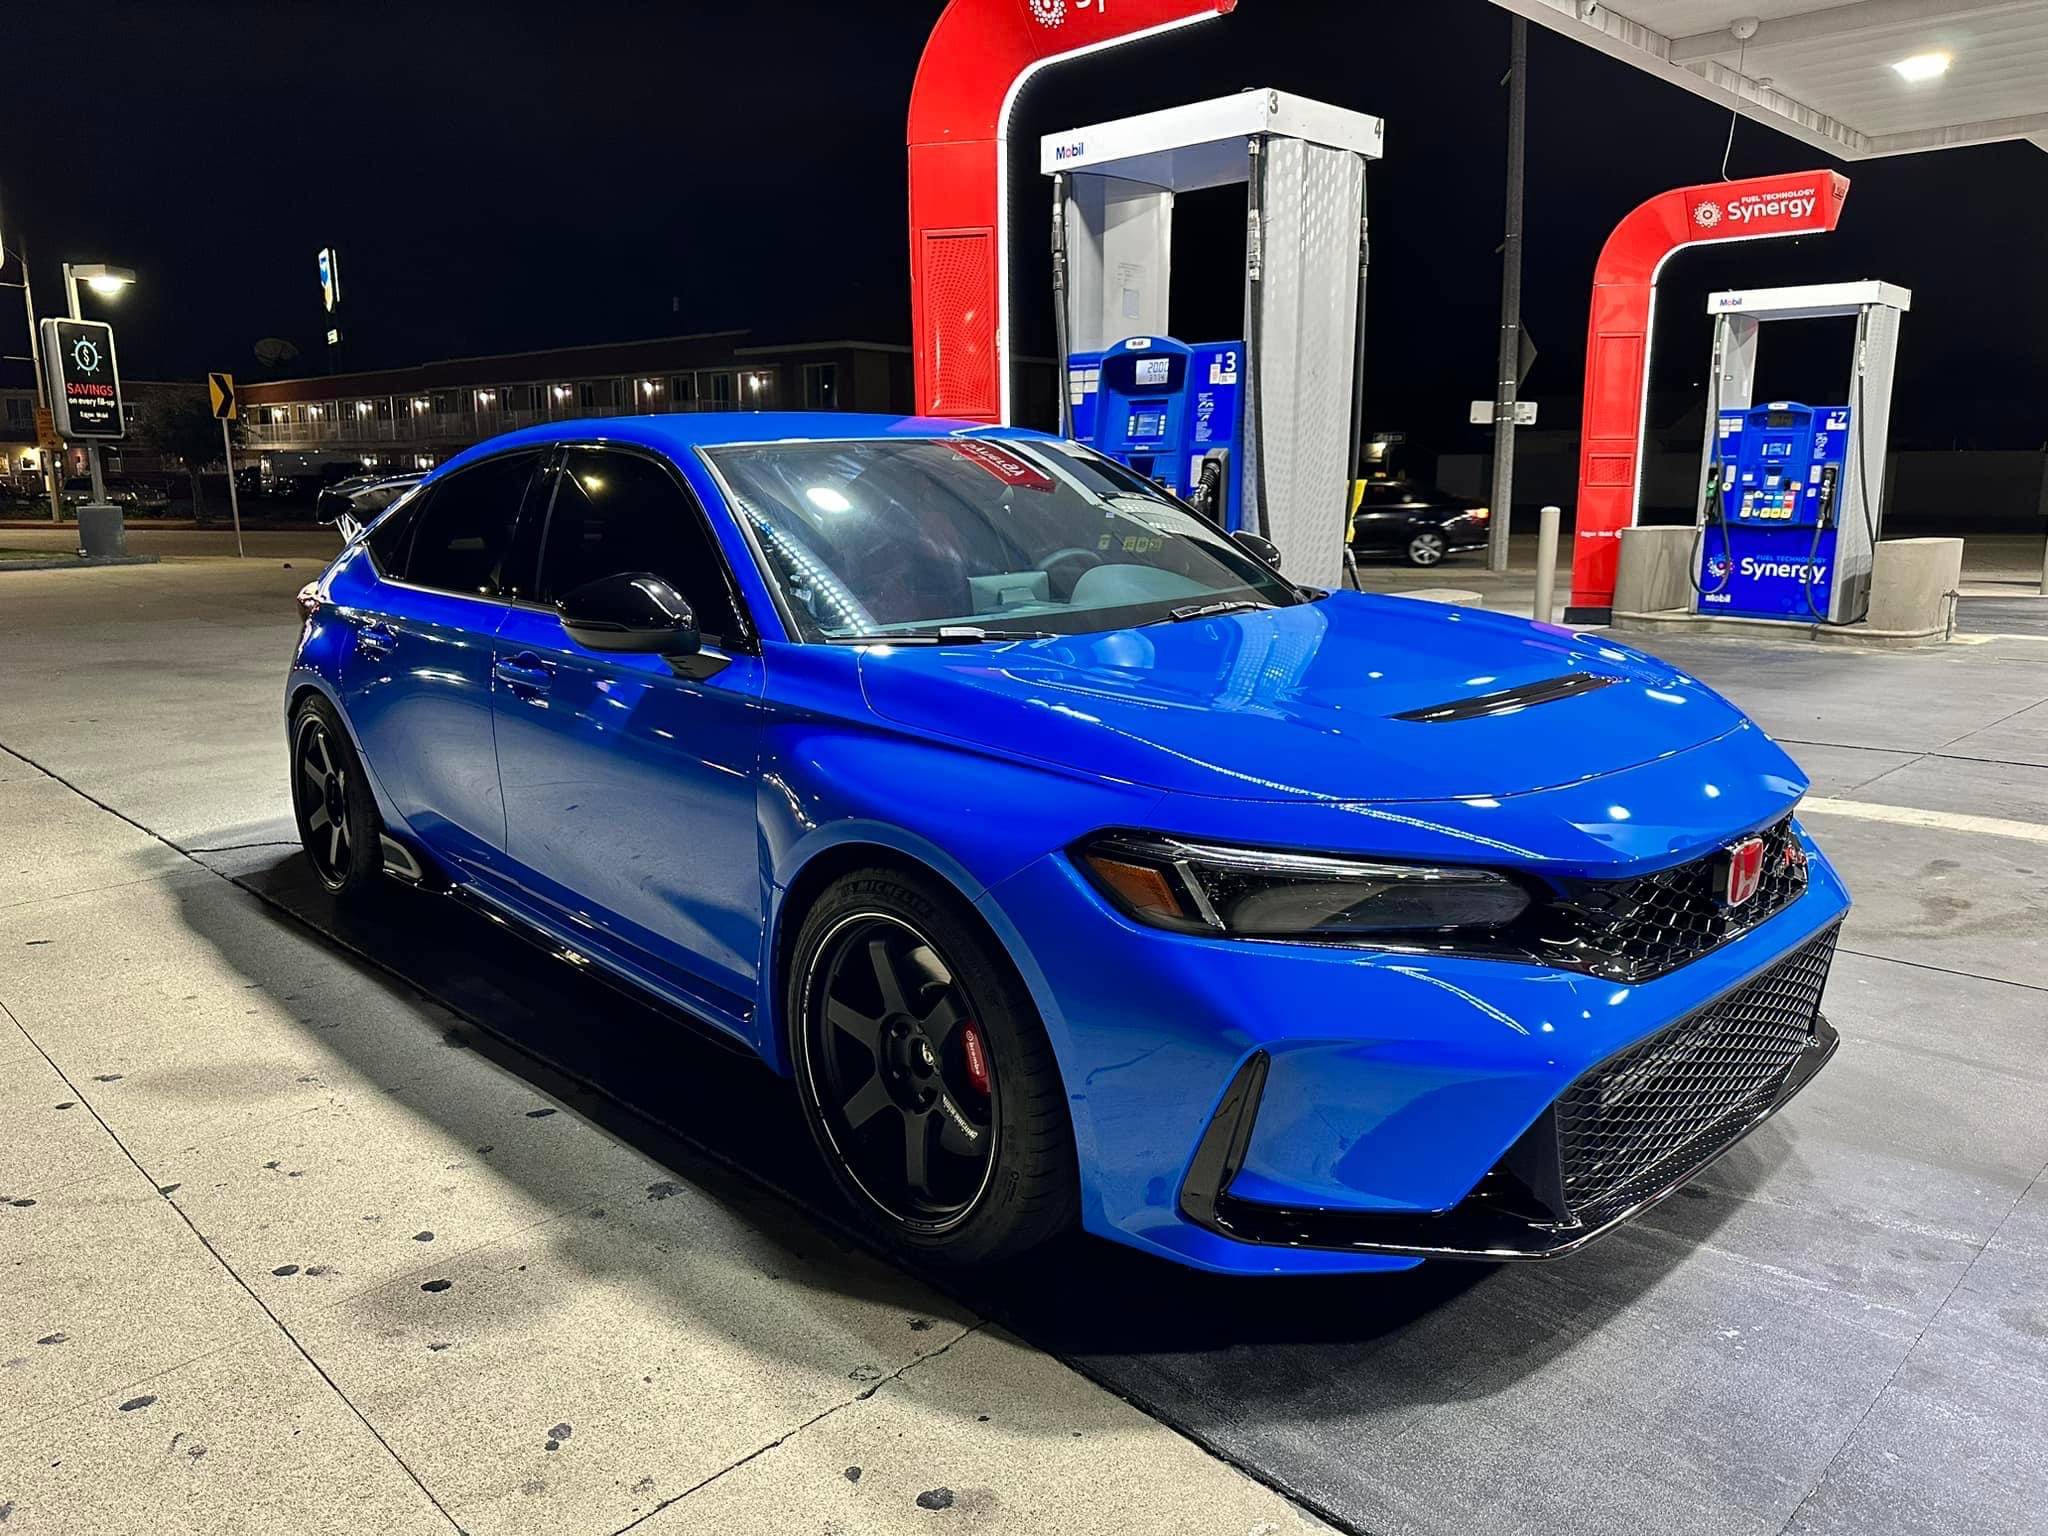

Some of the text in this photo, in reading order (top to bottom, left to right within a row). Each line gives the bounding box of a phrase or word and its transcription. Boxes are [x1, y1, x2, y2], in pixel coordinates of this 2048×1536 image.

[1269, 91, 1279, 115] 3
[1374, 119, 1382, 139] 4
[1055, 142, 1084, 161] Mobil
[1741, 188, 1815, 203] FUEL TECHNOLOGY
[1727, 197, 1816, 224] Synergy
[1720, 297, 1743, 307] Mobil
[1224, 351, 1236, 372] 3
[66, 382, 114, 397] SAVINGS
[1838, 411, 1847, 422] 7
[1740, 557, 1826, 585] Synergy
